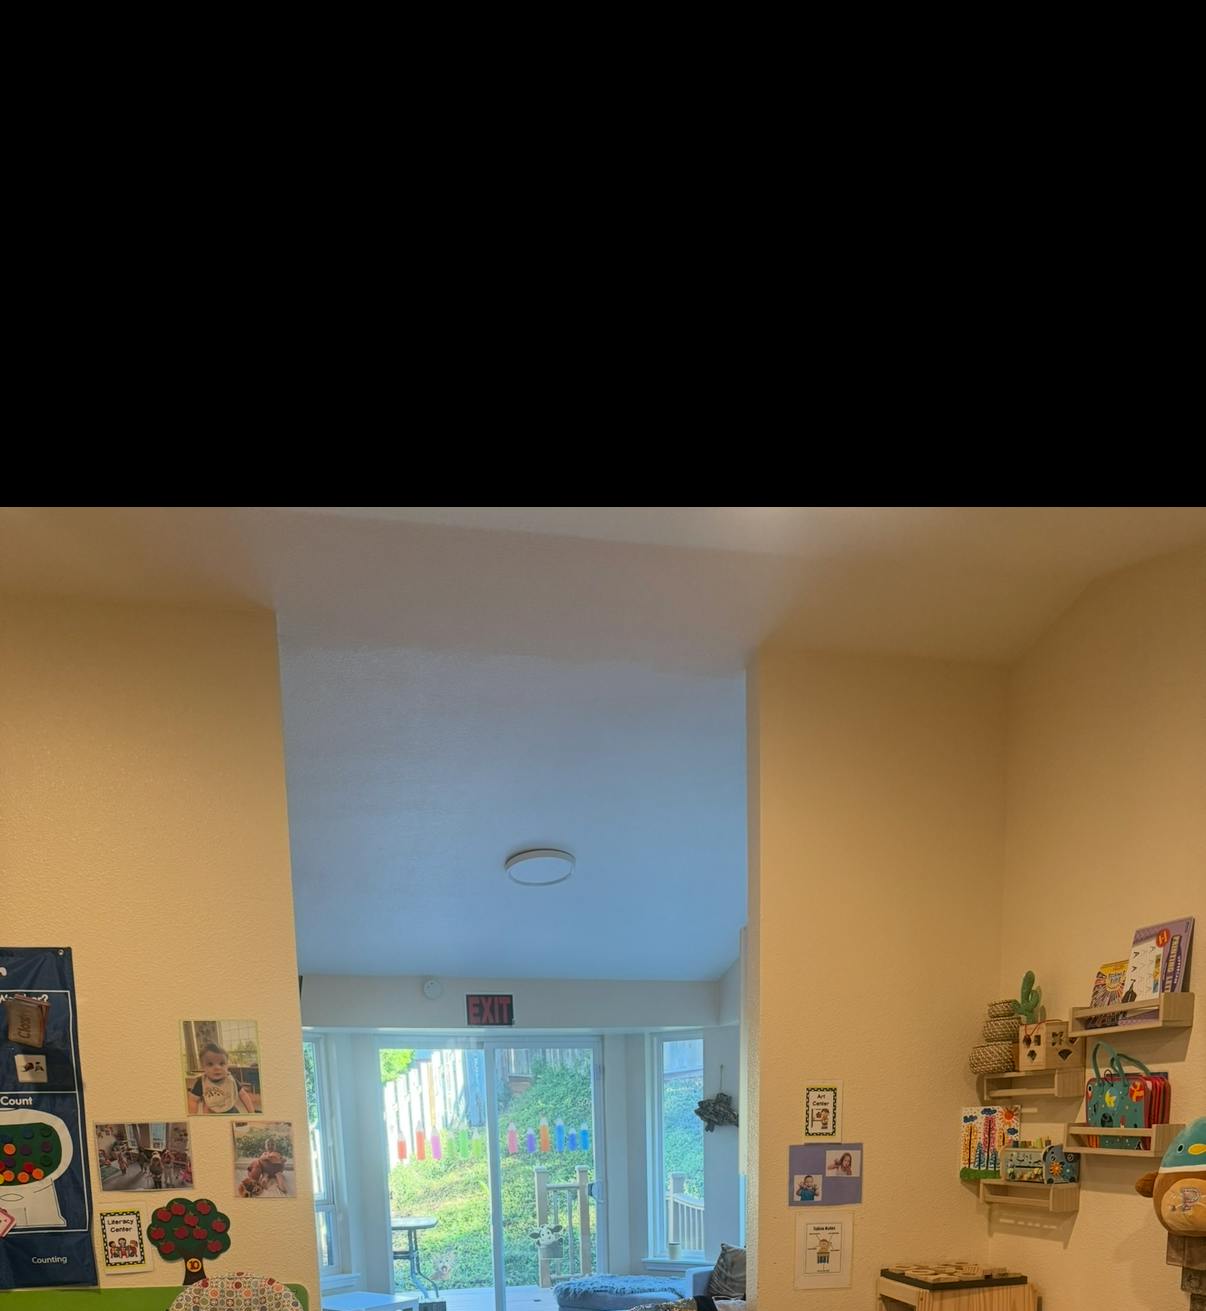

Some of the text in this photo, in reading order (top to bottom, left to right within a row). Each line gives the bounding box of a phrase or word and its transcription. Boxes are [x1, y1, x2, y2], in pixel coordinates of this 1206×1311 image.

[469, 997, 511, 1024] EXIT
[0, 1095, 33, 1106] Count
[31, 1256, 68, 1264] Counting
[188, 1261, 200, 1270] 10
